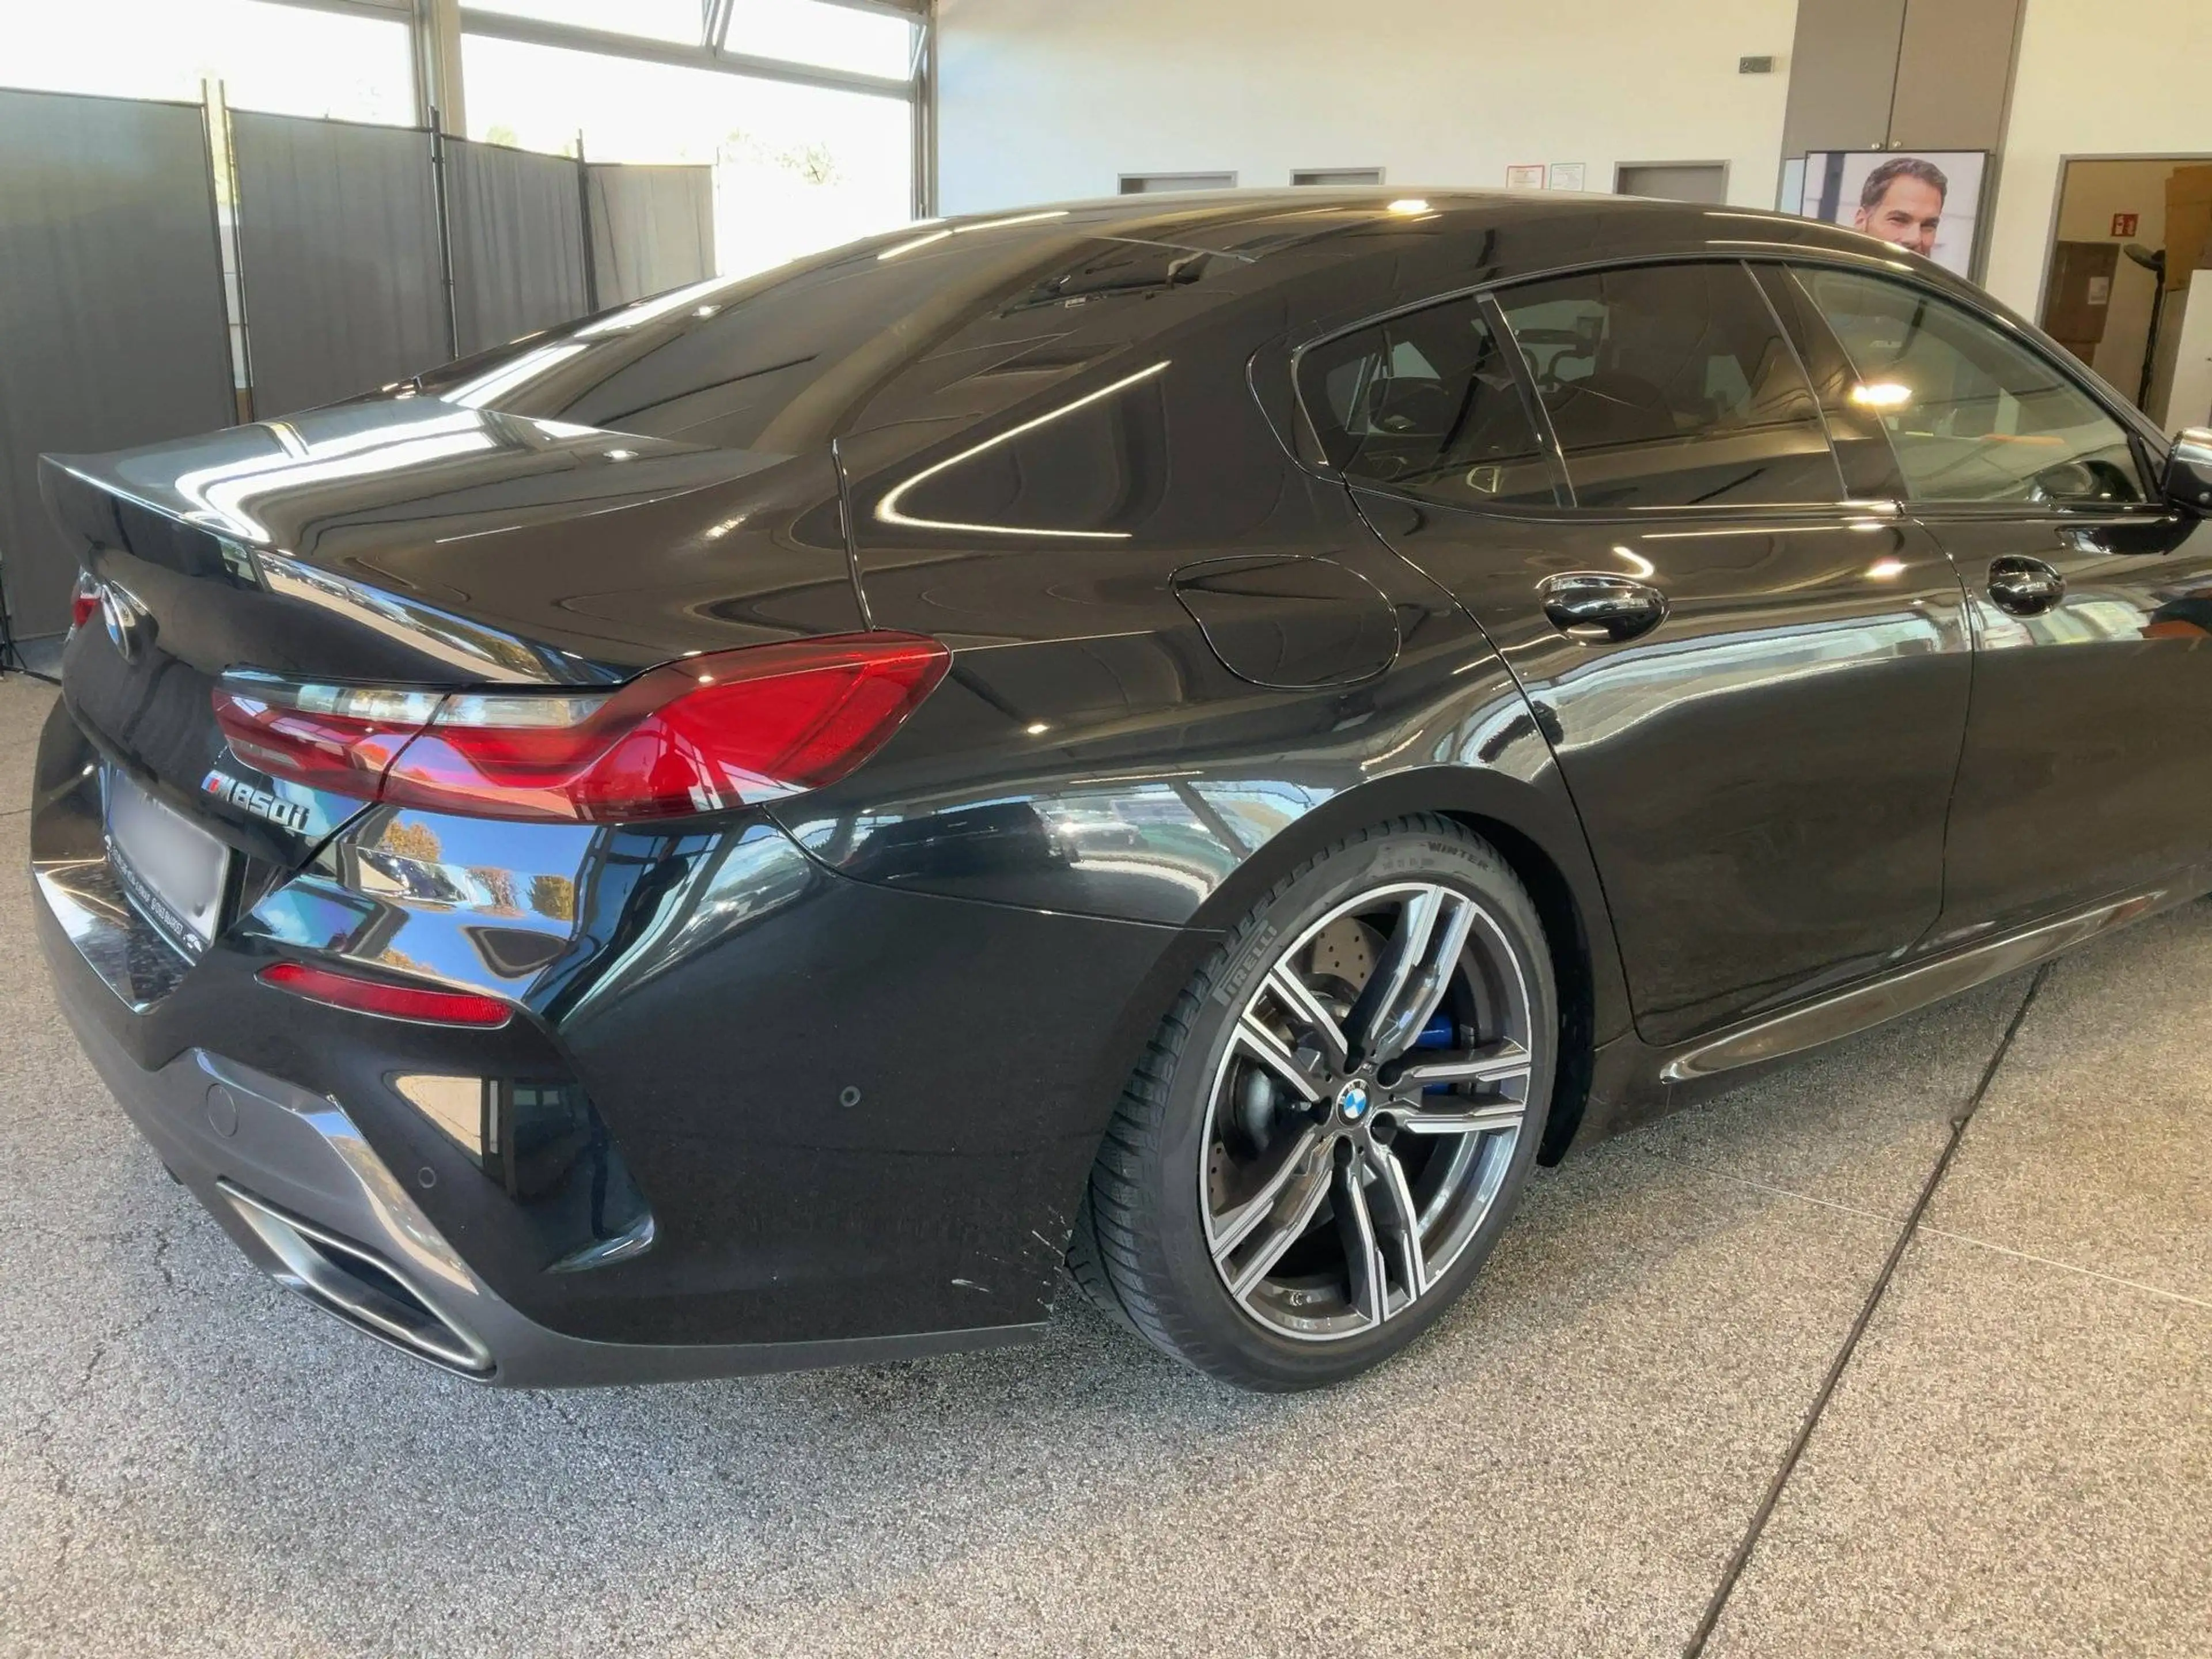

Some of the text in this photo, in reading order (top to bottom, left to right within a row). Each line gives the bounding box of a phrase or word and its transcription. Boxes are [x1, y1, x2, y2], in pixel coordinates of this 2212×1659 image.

[210, 770, 310, 830] M850i
[1427, 841, 1489, 871] WINTER
[1212, 920, 1278, 1007] PIRELLI
